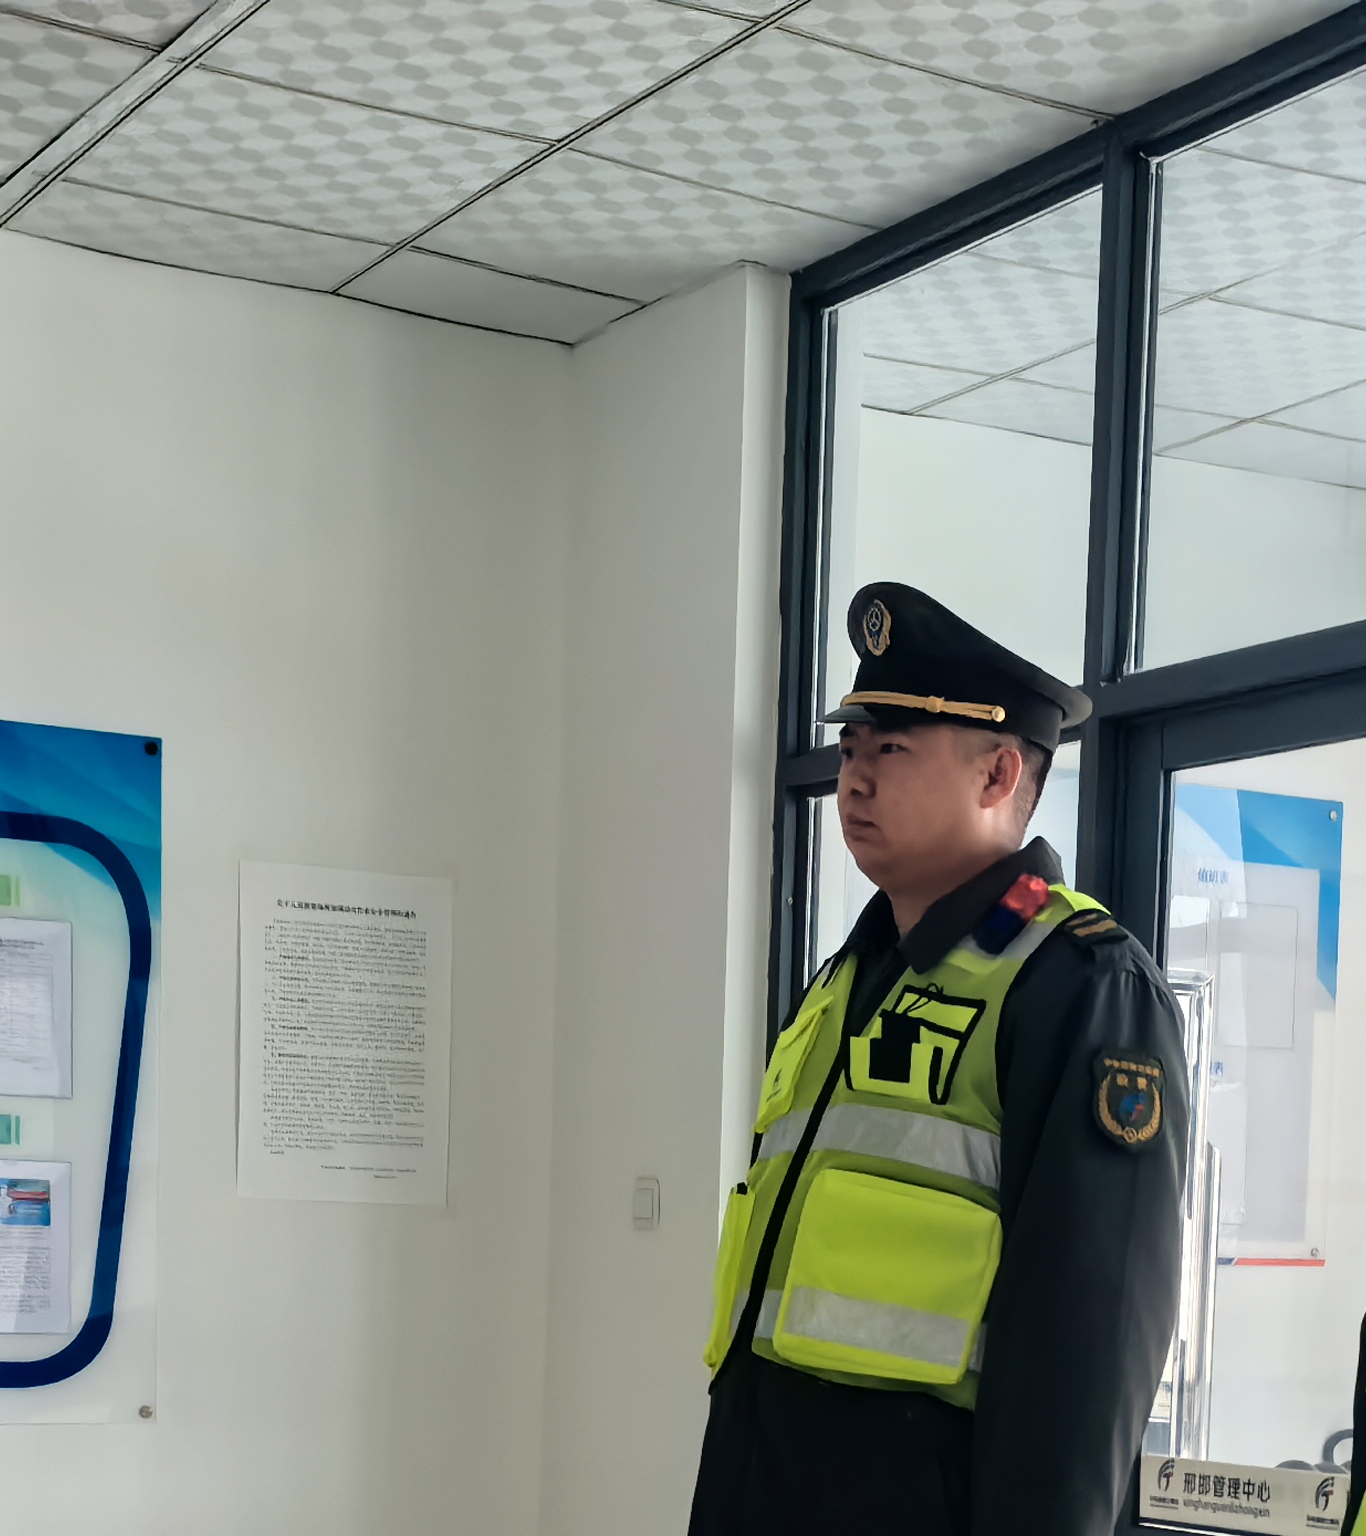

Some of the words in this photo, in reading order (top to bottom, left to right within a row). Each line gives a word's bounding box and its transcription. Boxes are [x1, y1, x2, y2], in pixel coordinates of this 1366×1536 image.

[1183, 1472, 1271, 1503] 邢邯管理中心
